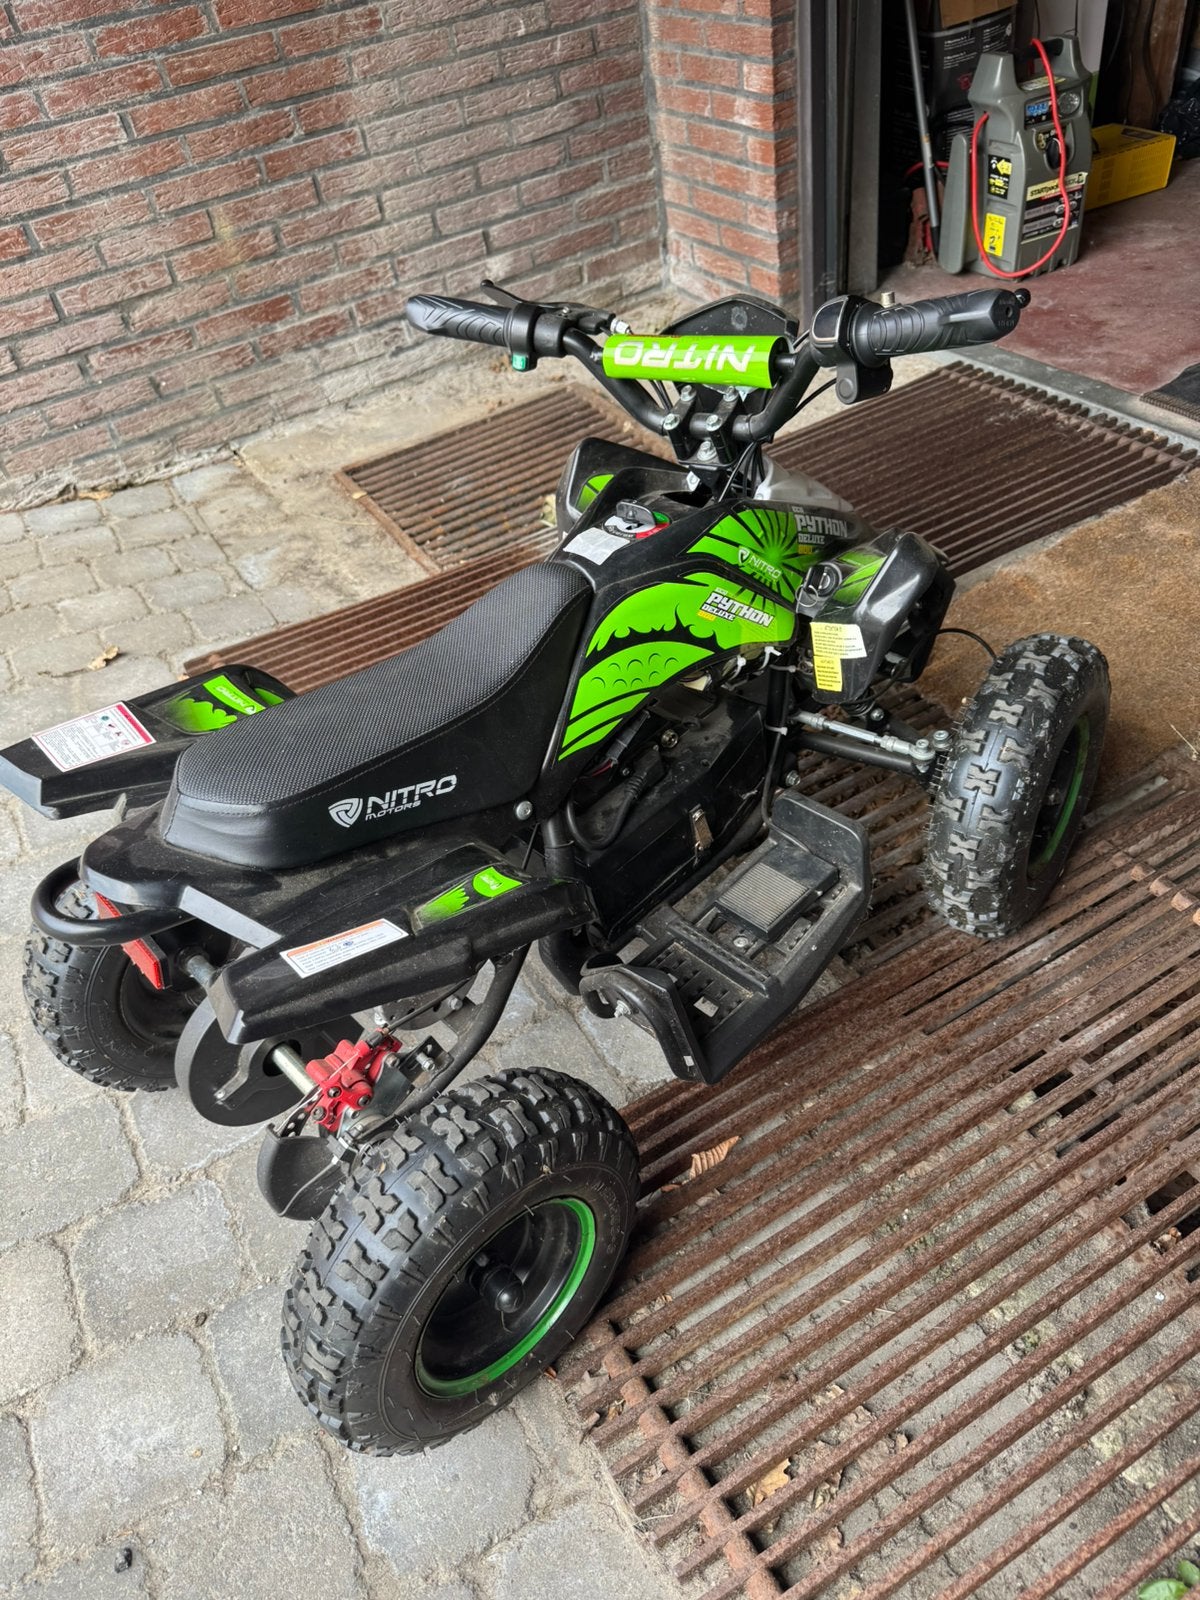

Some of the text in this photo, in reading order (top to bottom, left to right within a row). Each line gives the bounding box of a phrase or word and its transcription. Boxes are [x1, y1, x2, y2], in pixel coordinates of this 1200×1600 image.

[613, 341, 756, 372] NITRO
[794, 514, 848, 538] PYTHON
[798, 533, 825, 545] DELUXE
[748, 555, 782, 579] NITRO
[701, 603, 736, 621] DELUXE
[705, 591, 775, 627] PYTHON
[366, 774, 457, 815] NITRO
[365, 800, 421, 821] MOTORS
